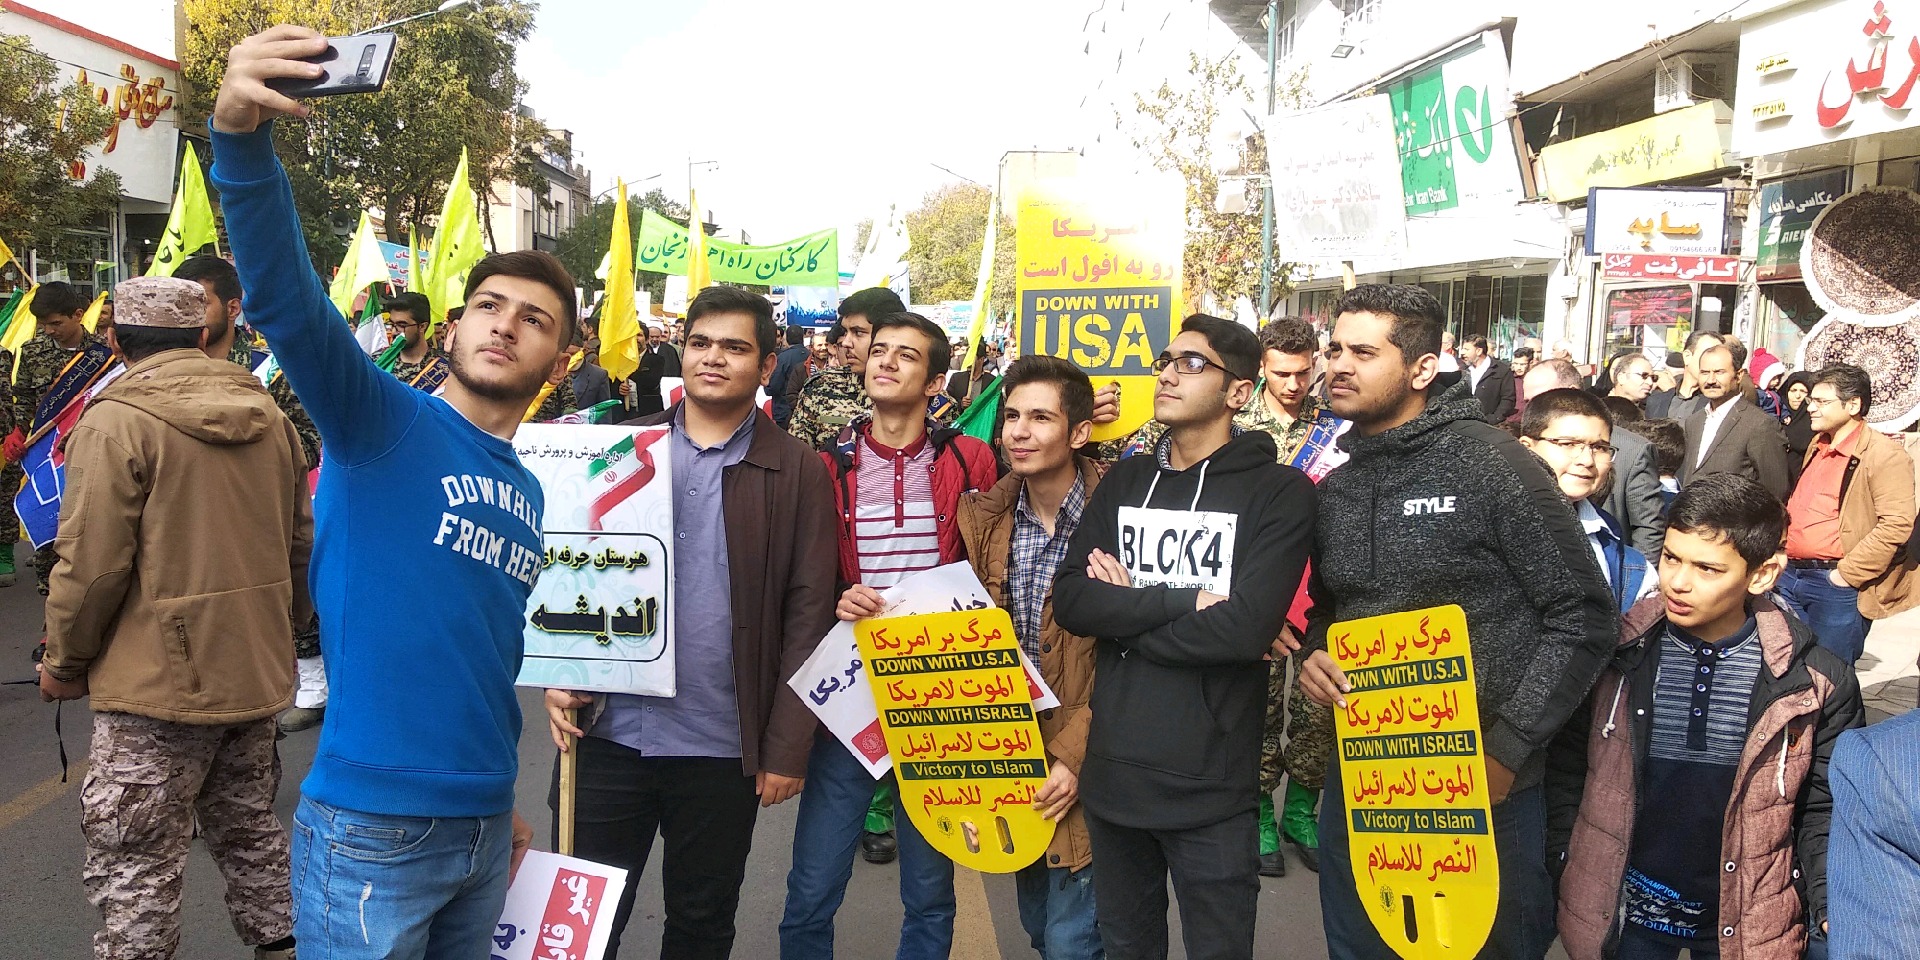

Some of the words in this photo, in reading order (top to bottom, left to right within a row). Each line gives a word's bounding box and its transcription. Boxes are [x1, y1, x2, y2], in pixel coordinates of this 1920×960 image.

[1818, 0, 1920, 128] رش
[1796, 191, 1832, 213] عکاسی
[1627, 211, 1700, 247] سایه
[641, 232, 689, 269] زنجان
[727, 251, 752, 269] راه
[756, 238, 830, 280] کارکنان
[1024, 256, 1067, 277] است
[1073, 253, 1118, 282] افول
[1125, 259, 1143, 279] به
[1150, 262, 1174, 280] رو
[1645, 257, 1678, 274] نت
[1678, 257, 1738, 280] کافی
[1035, 295, 1097, 311] DOWN
[1103, 294, 1159, 310] WITH
[1034, 312, 1156, 368] USA
[517, 445, 538, 458] ناحیه
[539, 444, 567, 459] پرورش
[575, 445, 605, 461] آموزش
[605, 452, 622, 463] اداره
[1404, 496, 1456, 516] STYLE
[433, 512, 505, 568] FROM
[558, 545, 590, 569] حرفه
[594, 547, 649, 570] هنرستان
[530, 594, 657, 644] اندیشه
[960, 617, 1002, 648] مرگ
[870, 626, 930, 656] امریکا
[937, 631, 955, 652] بر
[1335, 628, 1386, 667] امریکا
[1391, 636, 1409, 661] بر
[1412, 616, 1451, 655] مرگ
[875, 656, 924, 674] DOWN
[928, 653, 970, 669] WITH
[971, 650, 1014, 666] U.S.A
[1348, 670, 1380, 689] OWN
[1381, 664, 1419, 684] WITH
[1421, 659, 1462, 681] U.S.A
[886, 678, 954, 708] لامریکا
[959, 675, 1014, 703] الموت
[889, 711, 934, 726] DOWN
[934, 707, 973, 723] WITH
[973, 704, 1030, 721] ISRAEL
[1346, 696, 1404, 734] لامریکا
[1408, 689, 1458, 729] الموت
[900, 731, 973, 760] لاسرائیل
[976, 729, 1032, 757] الموت
[1345, 738, 1382, 757] DOWN
[1385, 736, 1419, 755] WITH
[1422, 733, 1474, 753] ISRAEL
[912, 763, 966, 778] Victory
[970, 763, 987, 775] to
[990, 760, 1035, 774] Islam
[1353, 766, 1416, 805] لاسرائیل
[1423, 764, 1474, 804] الموت
[923, 785, 981, 818] للاسلام
[1361, 811, 1411, 832] Victory
[1414, 811, 1430, 829] to
[1432, 811, 1475, 829] Islam
[1368, 842, 1422, 886] للاسلام
[560, 875, 594, 926] غیر
[593, 923, 627, 951] به
[1643, 920, 1698, 938] QUALITY
